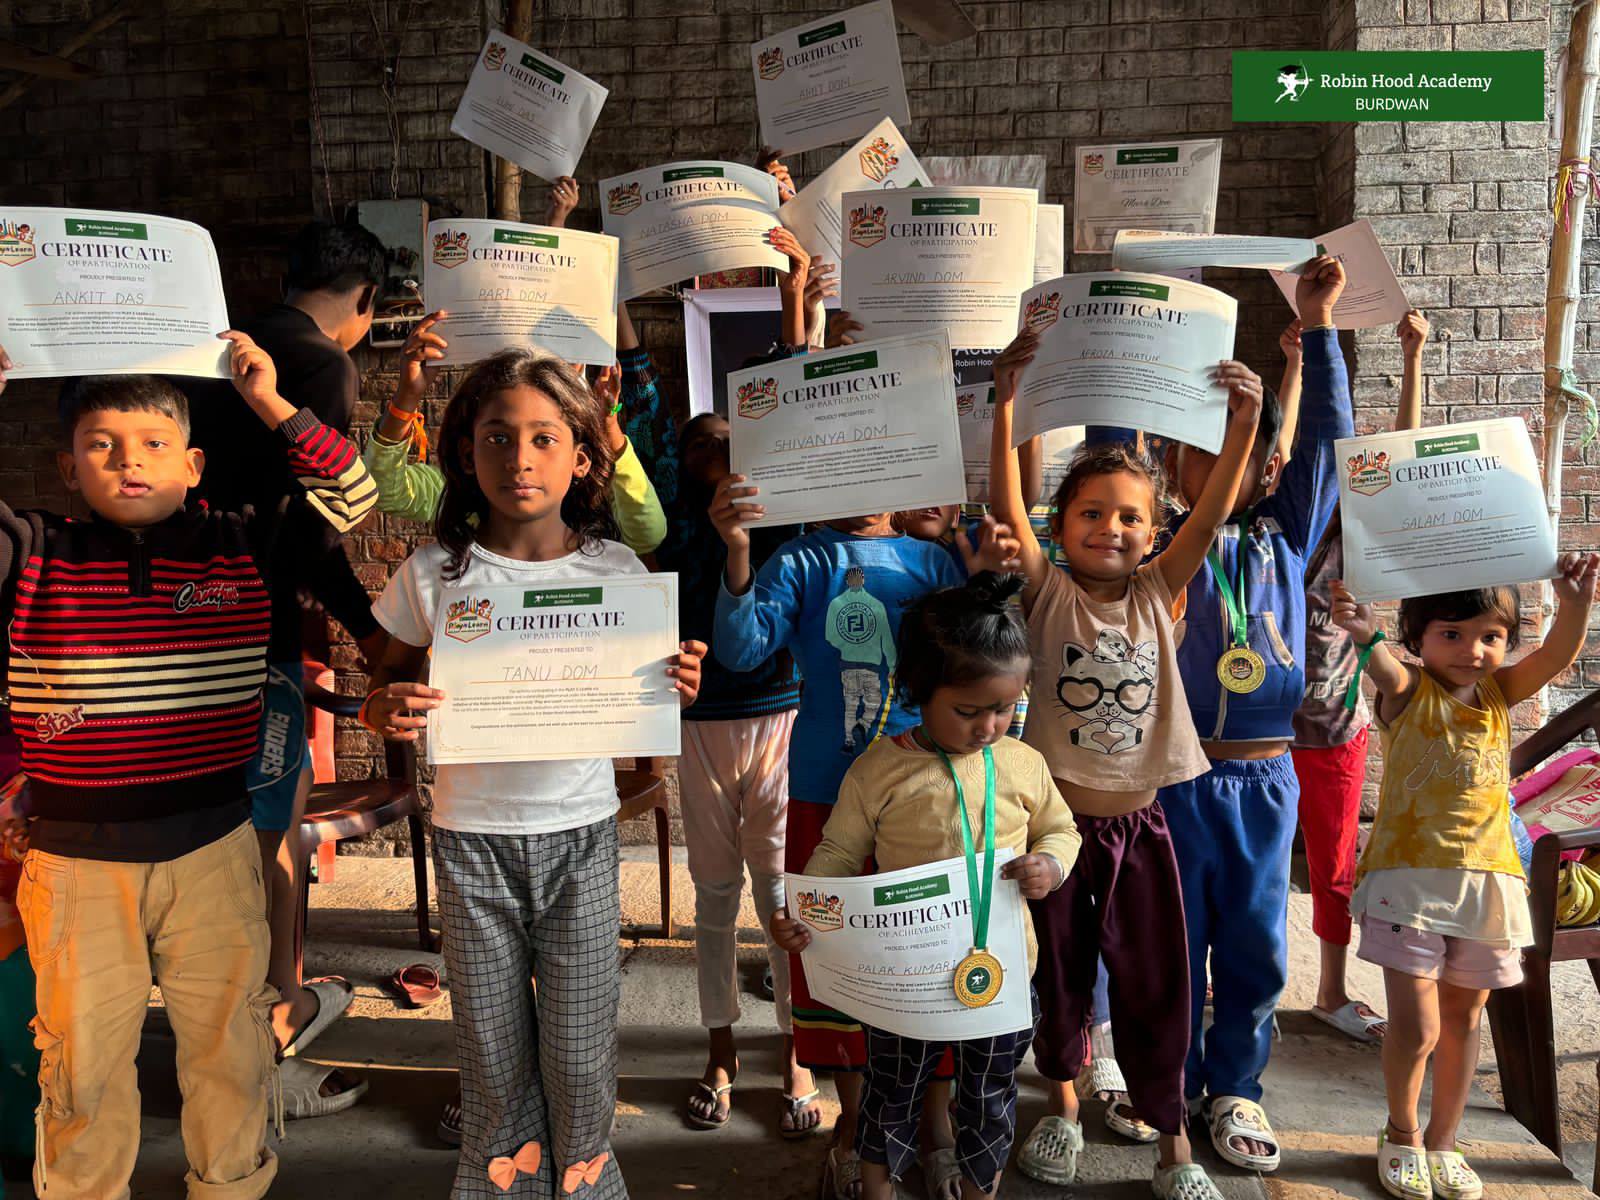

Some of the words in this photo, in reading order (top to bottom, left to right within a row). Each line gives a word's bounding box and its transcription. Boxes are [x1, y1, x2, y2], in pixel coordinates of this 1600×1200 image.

[786, 35, 863, 68] CERTIFICATE
[503, 63, 571, 105] CERTIFICATE
[1104, 167, 1189, 180] CERTIFICATE
[645, 181, 743, 202] CERTIFICATE
[890, 222, 998, 237] CERTIFICATE
[41, 243, 173, 263] CERTIFICATE
[472, 247, 577, 269] CERTIFICATE
[82, 261, 151, 269] PARTICIPATION
[885, 272, 926, 284] ARVIND
[935, 271, 964, 283] DOM
[53, 291, 107, 304] ANKIT
[115, 292, 145, 305] DAS
[1063, 302, 1188, 326] CERTIFICATE
[1096, 318, 1163, 329] PARTICIPATION
[955, 359, 976, 368] Robin
[783, 371, 902, 404] CERTIFICATE
[817, 392, 880, 408] PARTICIPATION
[775, 431, 845, 452] SHIVANYA
[854, 424, 888, 441] DOM
[1395, 455, 1502, 483] CERTIFICATE
[1430, 475, 1486, 489] PARTICIPATION
[1402, 513, 1445, 529] SALAM
[1453, 508, 1483, 521] DOM
[496, 611, 625, 631] CERTIFICATE
[533, 630, 601, 640] PARTICIPATION
[502, 665, 551, 681] TANU
[562, 664, 598, 680] DOM
[34, 704, 86, 743] Star
[849, 899, 971, 928] CERTIFICATE
[892, 922, 951, 937] ACHIEVEMENT
[910, 941, 939, 949] PRESENTED
[857, 963, 896, 975] PALAK
[904, 959, 957, 975] KUMARI
